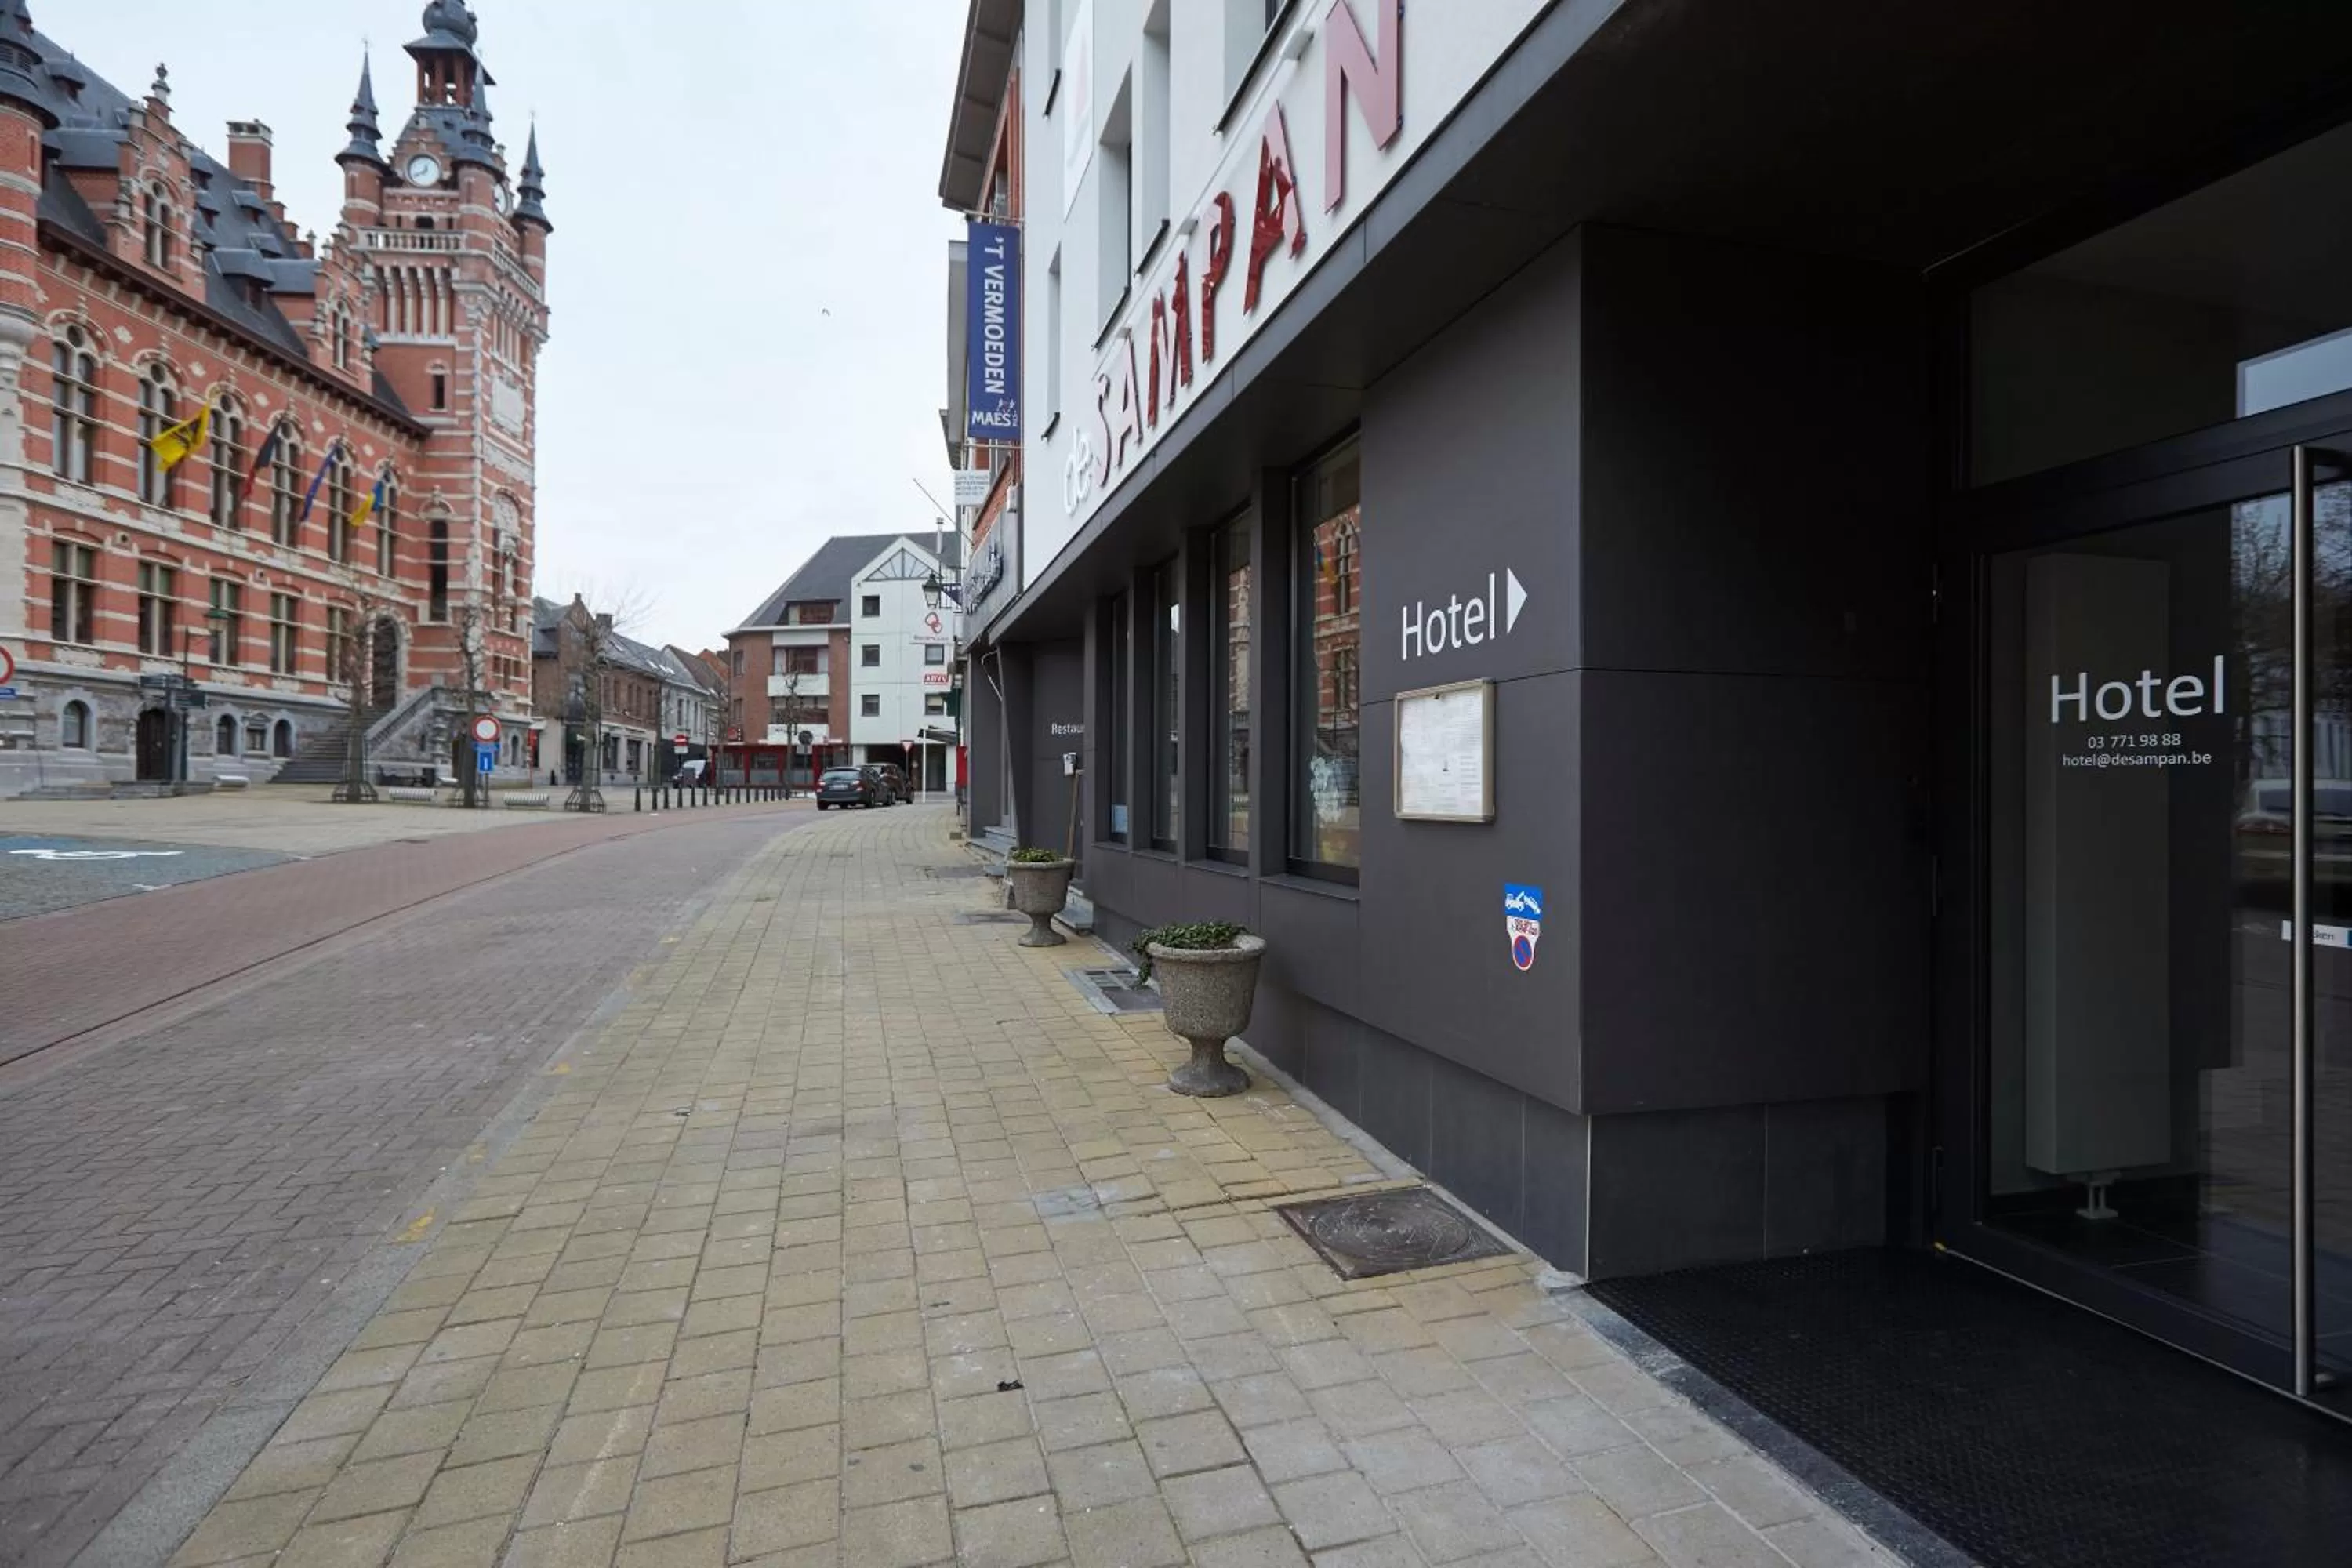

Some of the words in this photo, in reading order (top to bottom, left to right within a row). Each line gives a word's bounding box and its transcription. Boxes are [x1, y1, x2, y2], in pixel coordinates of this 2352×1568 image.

[1064, 426, 1093, 517] de
[1094, 0, 1405, 488] SAMPAN
[984, 264, 1004, 394] VERMOEDEN
[971, 410, 1011, 427] MAES
[1402, 572, 1496, 661] Hotel
[2050, 654, 2225, 724] Hotel
[2062, 750, 2213, 768] hotel@desampan.be
[2087, 736, 2106, 749] 03
[2110, 735, 2136, 748] 771
[2139, 734, 2158, 747] 98
[2161, 733, 2182, 746] 88
